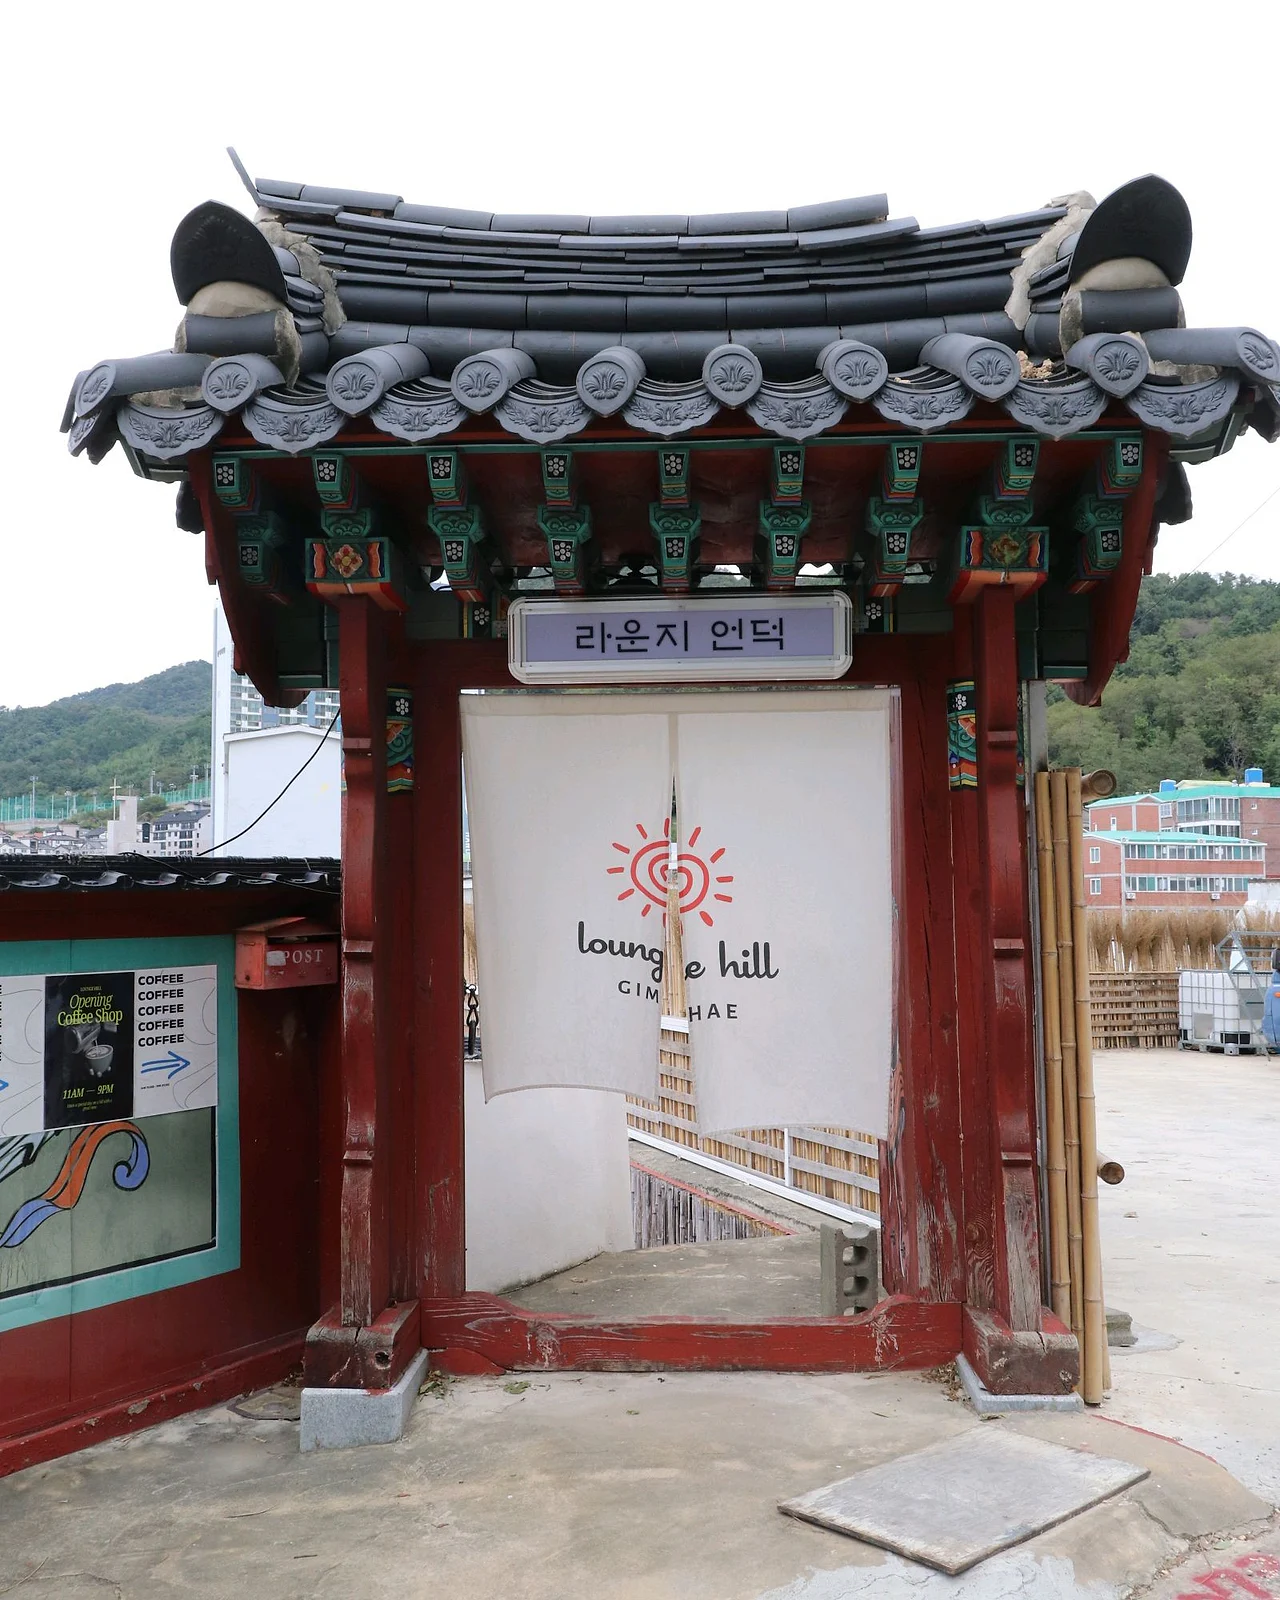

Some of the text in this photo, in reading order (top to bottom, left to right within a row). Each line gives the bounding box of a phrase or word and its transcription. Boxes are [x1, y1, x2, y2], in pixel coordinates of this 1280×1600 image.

[575, 617, 785, 653] 라운지 언덕
[577, 920, 780, 983] lounge hill
[137, 973, 184, 986] COFFEE
[69, 992, 114, 1011] Opening
[137, 988, 184, 1001] COFFEE
[57, 1007, 123, 1027] Coffee Shop
[137, 1003, 184, 1016] COFFEE
[137, 1018, 185, 1032] COFFEE
[137, 1033, 185, 1047] COFFEE
[62, 1087, 85, 1100] 11AM
[97, 1083, 115, 1095] 9PM
